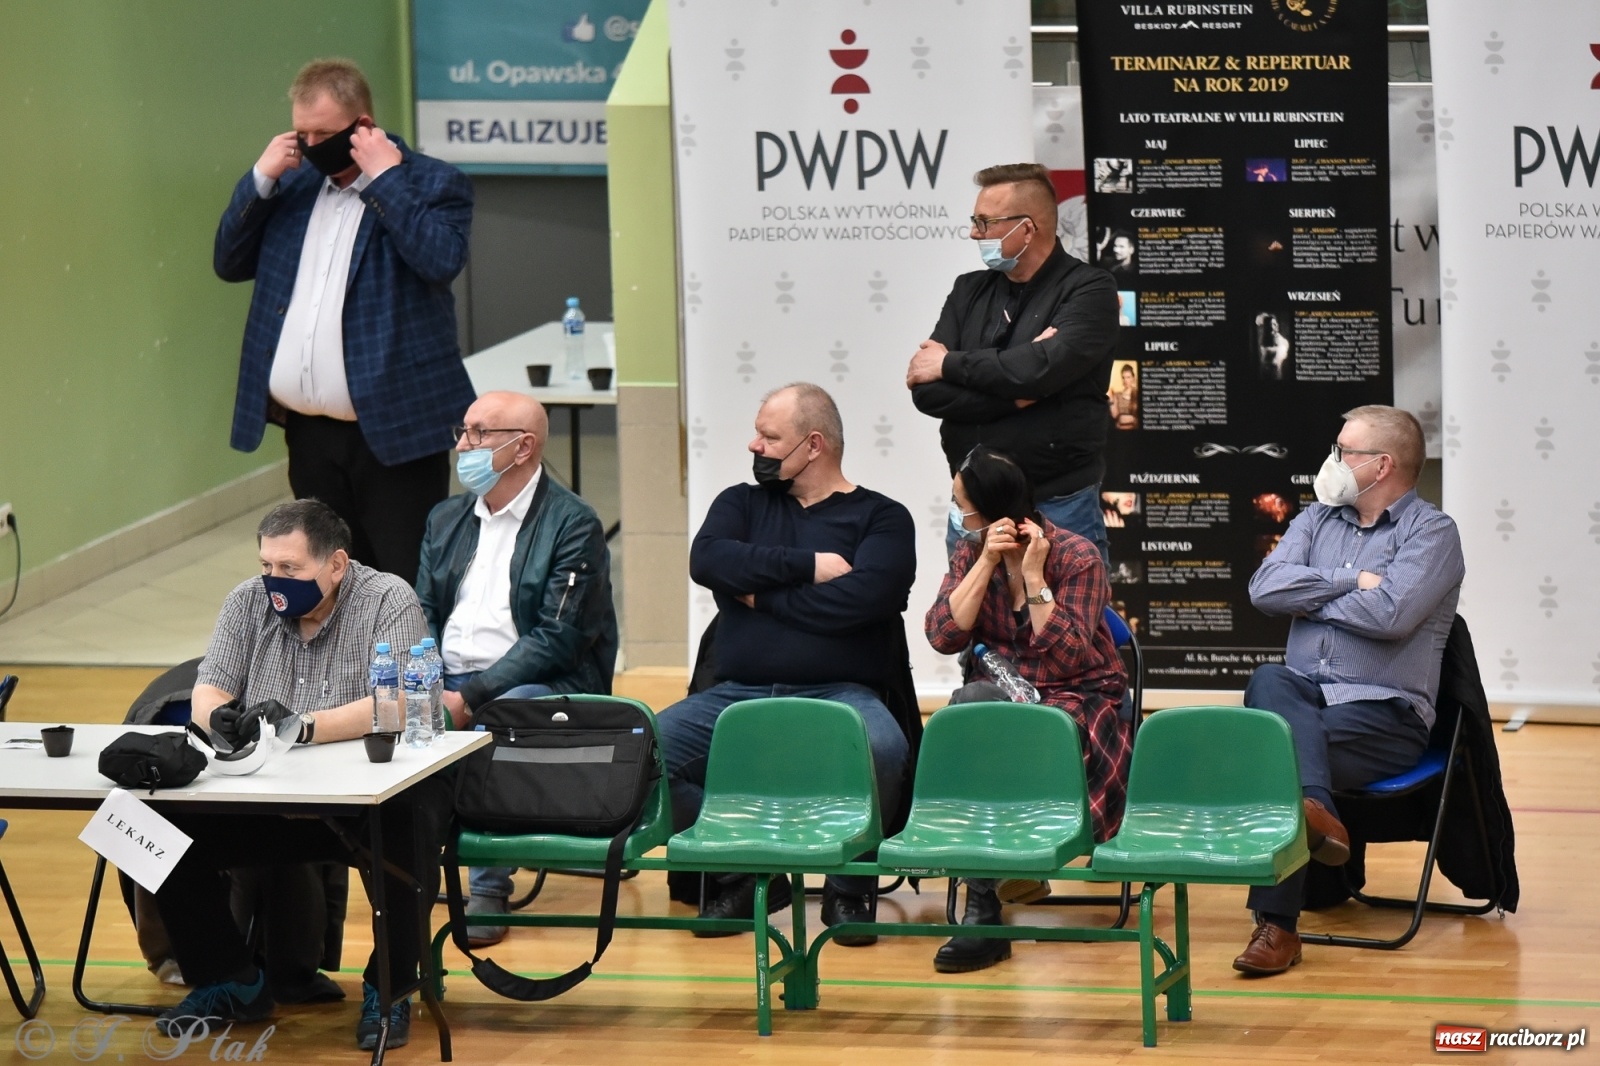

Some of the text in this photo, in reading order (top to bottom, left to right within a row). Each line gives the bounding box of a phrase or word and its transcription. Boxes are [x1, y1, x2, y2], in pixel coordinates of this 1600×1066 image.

[1120, 4, 1253, 16] VILLA RUBINSTEIN
[1134, 21, 1242, 30] BESKIDY RESORT
[1111, 54, 1351, 71] TERMINARZ & REPERTUAR
[450, 60, 480, 83] ul.
[486, 60, 607, 87] Opawska
[1173, 77, 1289, 93] NA ROK 2019
[1119, 111, 1344, 123] LATO TEATRALNE W VILLI RUBINSTEIN
[446, 119, 607, 145] REALIZUJE
[1145, 139, 1168, 151] MAJ
[1294, 139, 1328, 149] LIPIEC
[755, 129, 949, 192] PWPW
[762, 202, 949, 221] POLSKA WYTWÓRNIA
[1130, 207, 1186, 218] CZERWIEC
[1288, 206, 1336, 219] SIERPIEŃ
[1519, 202, 1588, 218] POLSKA
[729, 223, 819, 242] PAPIERÓW
[1485, 220, 1576, 240] PAPIERÓW
[1287, 290, 1341, 302] WRZESIEŃ
[1144, 341, 1179, 352] LIPIEC
[1129, 472, 1201, 484] PAŹDZIERNIK
[1141, 541, 1193, 552] LISTOPAD
[106, 813, 167, 860] LEKARZ
